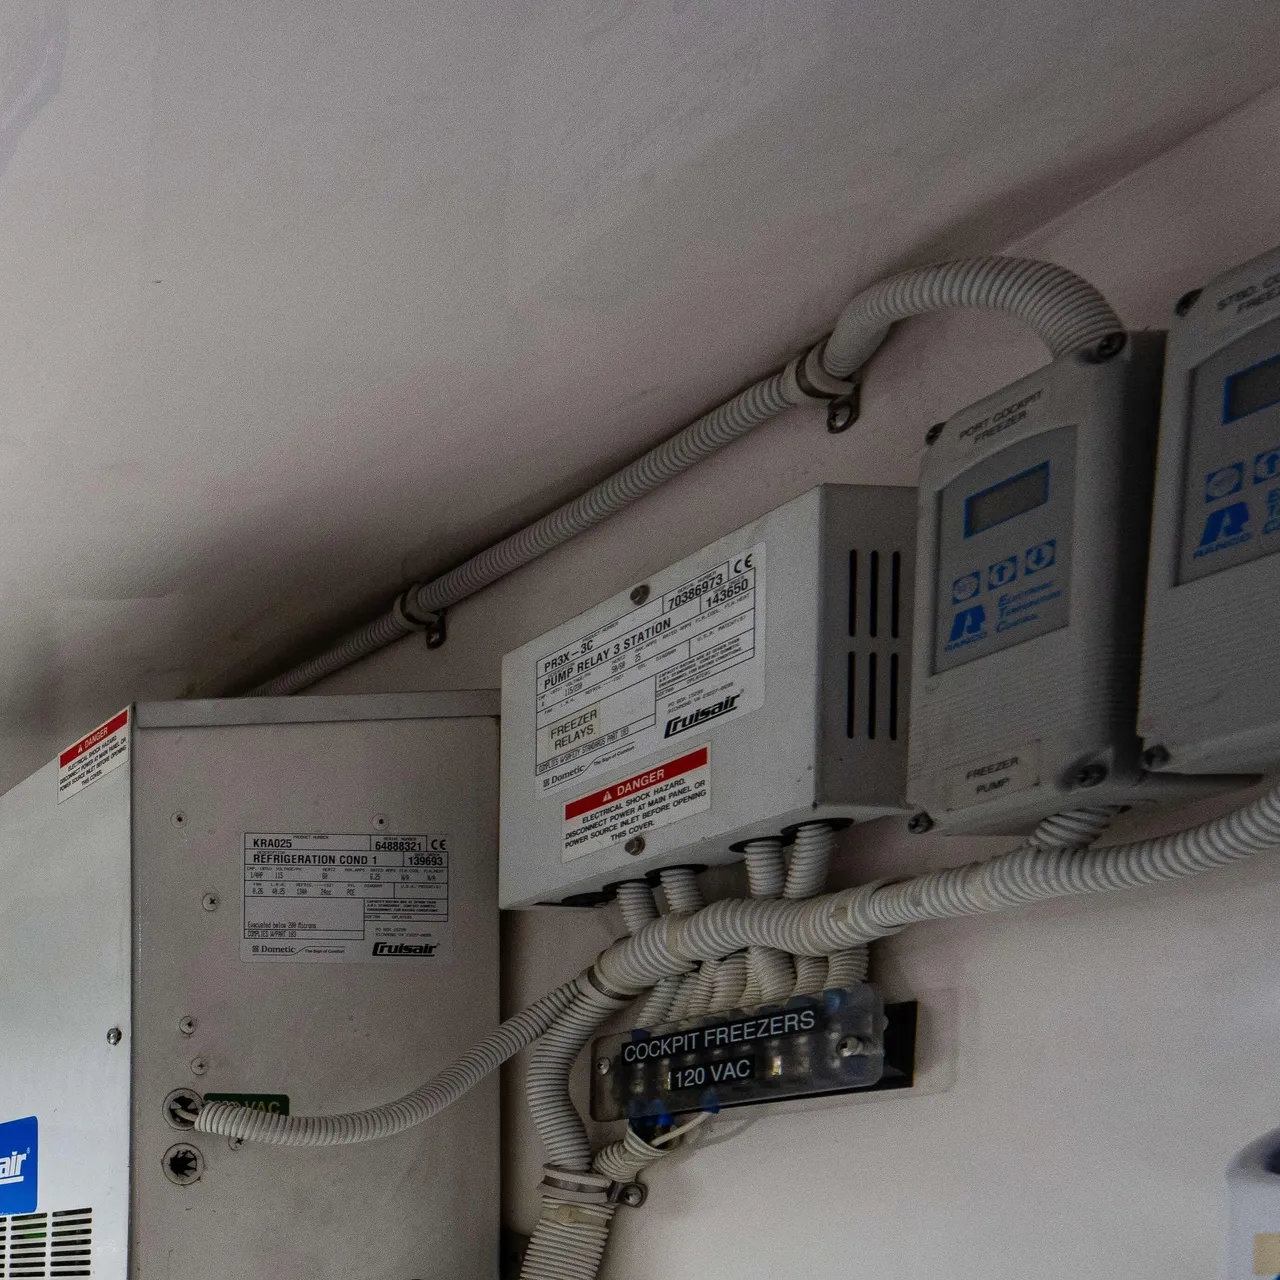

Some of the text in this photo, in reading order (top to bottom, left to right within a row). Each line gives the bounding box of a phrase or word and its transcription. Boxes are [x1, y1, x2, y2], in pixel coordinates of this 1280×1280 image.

[991, 389, 1043, 422] COCKPIT
[973, 410, 1027, 443] FREEZER
[668, 573, 723, 611] 70386973
[706, 578, 748, 608] 143650
[544, 667, 574, 690] PUMP
[577, 648, 610, 673] RELAY
[613, 643, 620, 655] 3
[623, 617, 671, 650] STATION
[550, 709, 597, 740] FREEZER
[664, 694, 740, 739] Cruisair
[84, 726, 108, 749] DANGER
[60, 768, 80, 784] DISCONNECT
[81, 759, 94, 770] POWER
[98, 750, 108, 758] MAIN
[108, 742, 120, 752] PANEL
[60, 744, 126, 792] POWER SOURCE INLET BEFORE OPENING
[68, 755, 88, 772] ELECTRICAL
[88, 746, 101, 758] SHOCK
[966, 756, 1019, 780] FREEZER
[82, 778, 90, 786] THIS
[552, 765, 586, 784] Dometic
[616, 768, 665, 796] DANGER
[976, 777, 1010, 794] PUMP
[565, 780, 706, 840] DISCONNECT POWER AT MAIN PANEL OR
[582, 778, 686, 824] ELECTRICAL SHOCK HAZARD.
[564, 789, 707, 849] POWER SOURCE INLET BEFORE OPENING
[610, 820, 654, 841] THIS COVER.
[252, 838, 292, 848] KRA025
[375, 841, 421, 850] 64888321
[253, 854, 444, 866] REFRIGERATION COND 1 139693
[248, 921, 271, 929] Evacuated
[261, 945, 295, 953] Dometic
[372, 942, 438, 957] Cruisair
[624, 1010, 815, 1062] COCKPIT FREEZERS
[676, 1059, 750, 1088] 120 VAC
